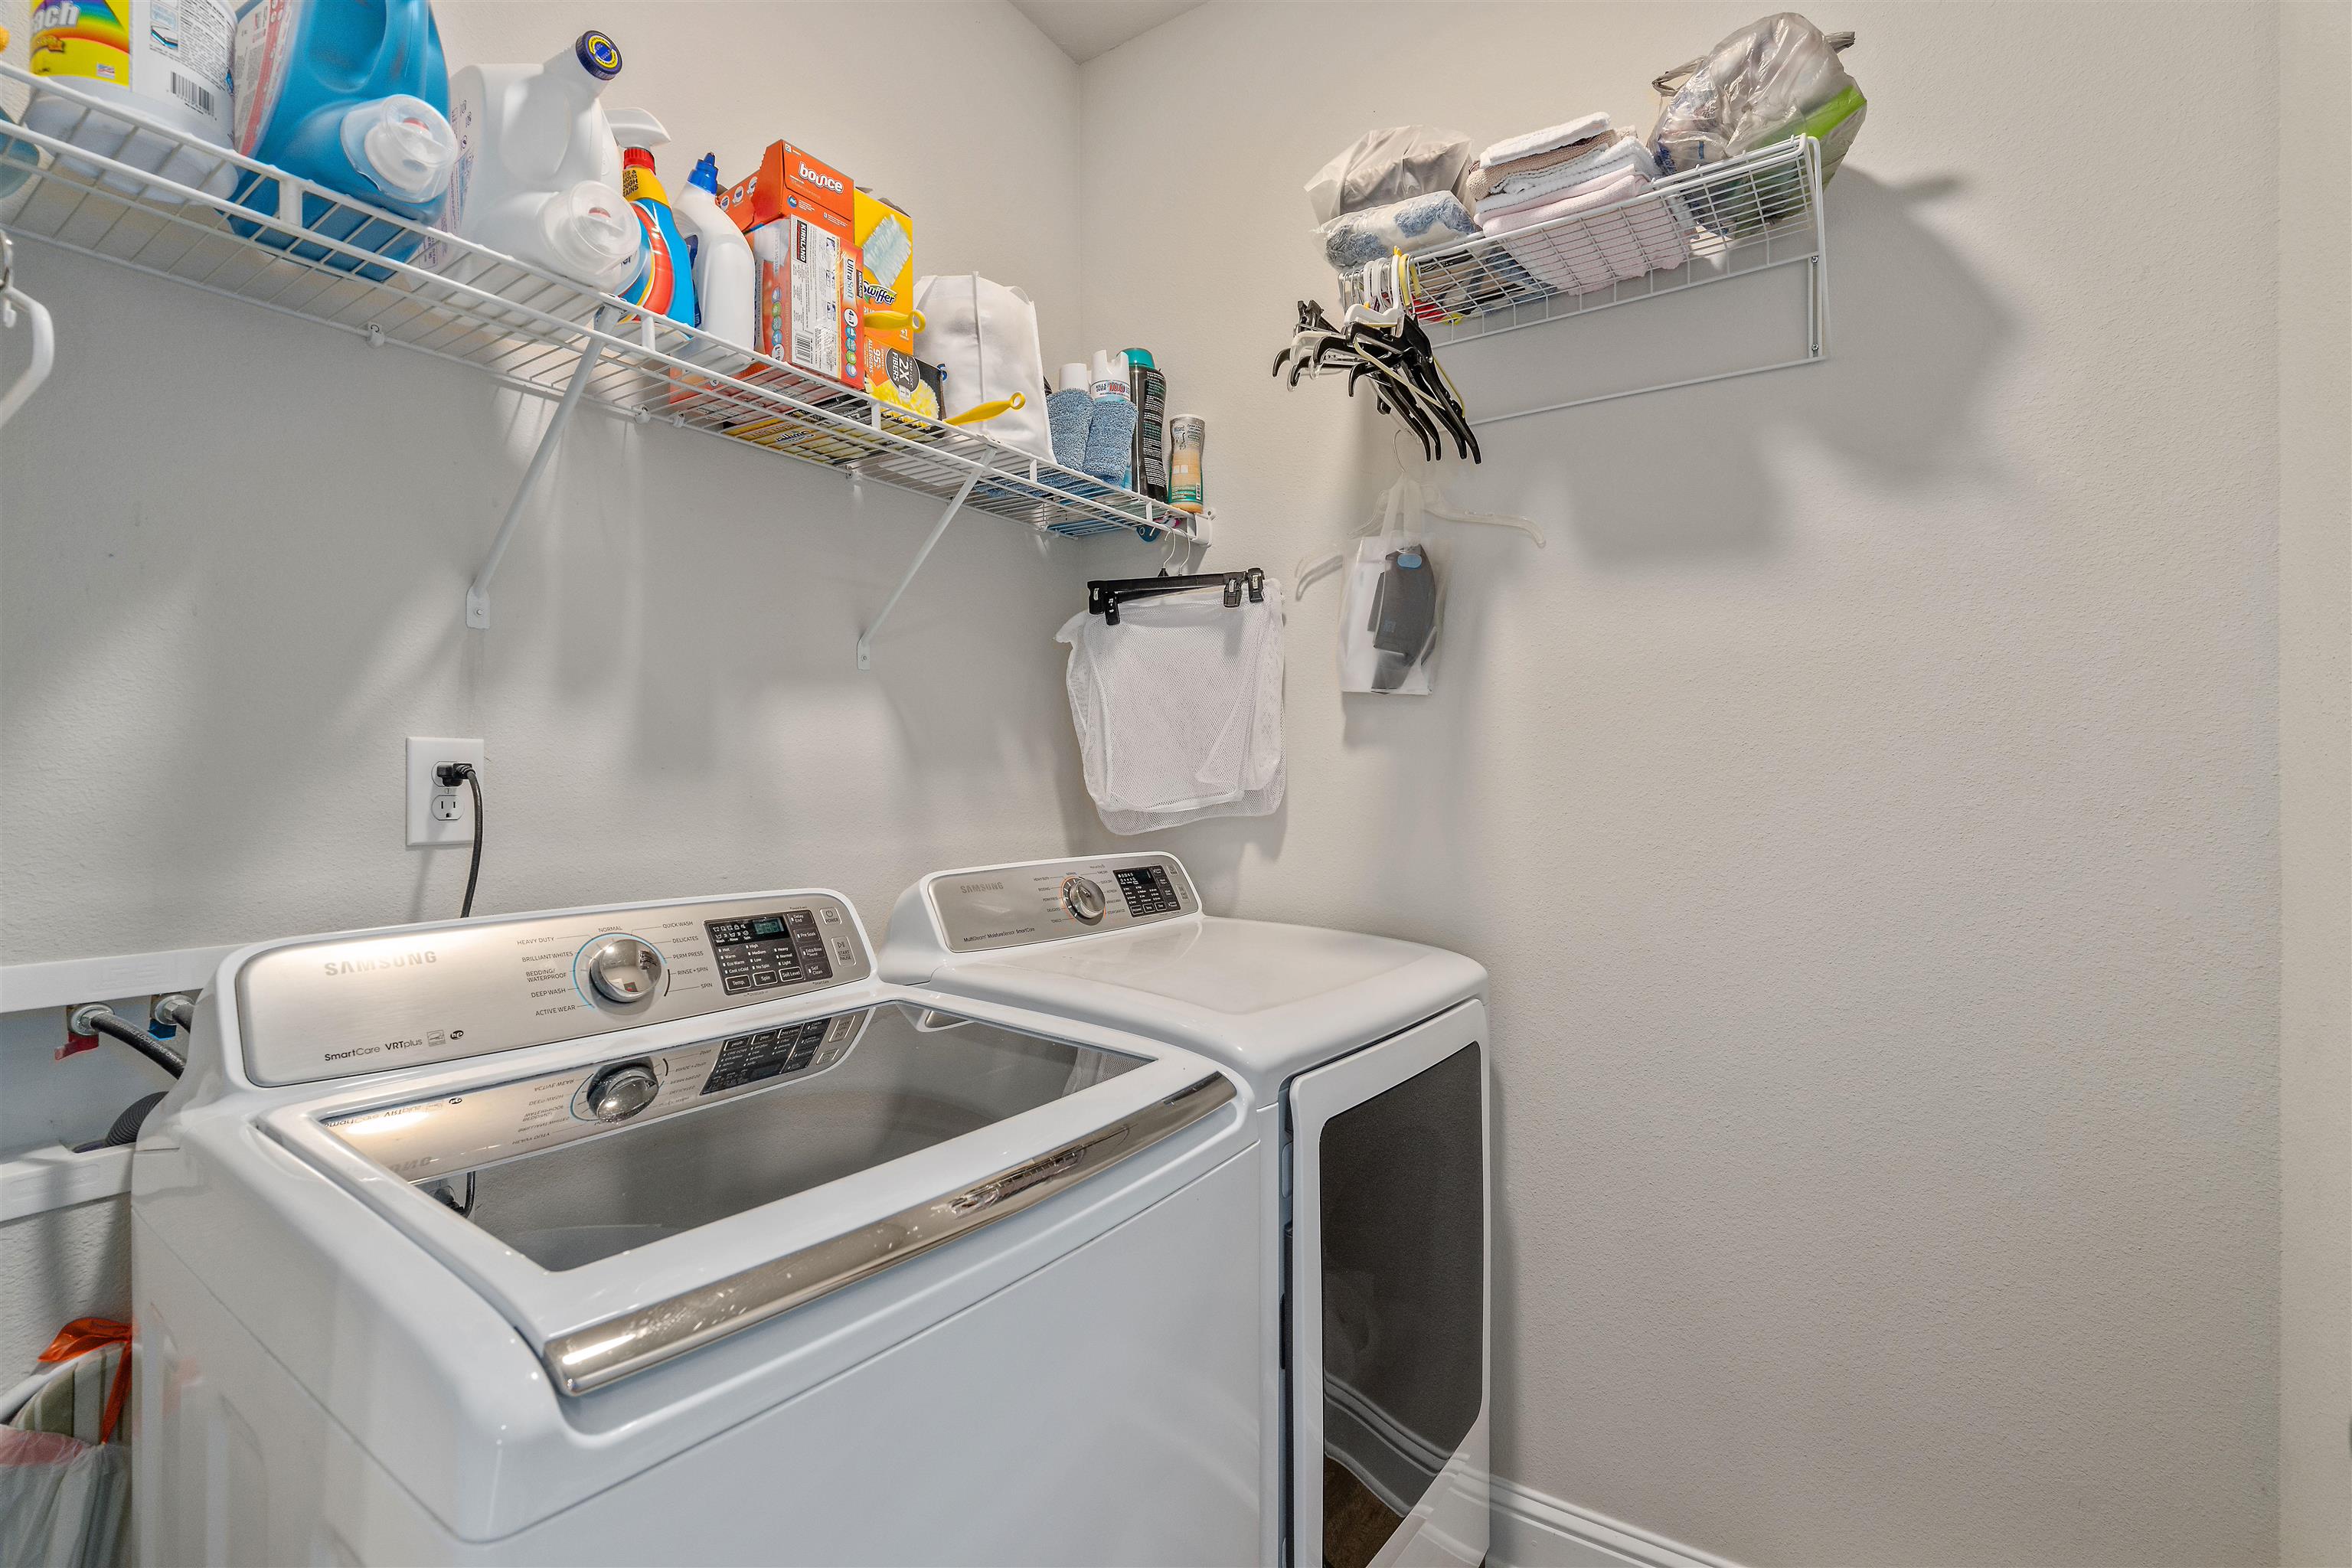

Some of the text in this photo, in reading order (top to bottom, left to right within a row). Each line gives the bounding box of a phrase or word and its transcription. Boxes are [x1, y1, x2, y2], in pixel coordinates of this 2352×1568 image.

[623, 178, 639, 191] OUGH
[799, 162, 844, 194] bounce
[864, 280, 895, 305] Swiffer
[899, 358, 910, 384] 2X
[1109, 382, 1125, 394] 100
[960, 881, 1004, 894] SAMSUNG
[324, 951, 437, 976] SAMSUNG
[521, 953, 551, 962] BRILLIANT
[526, 968, 556, 977] BEDDING/
[527, 972, 567, 982] WATERPROOF
[535, 1004, 576, 1017] ACTIVE WEAR
[325, 1037, 423, 1061] SmartCare VRTplus
